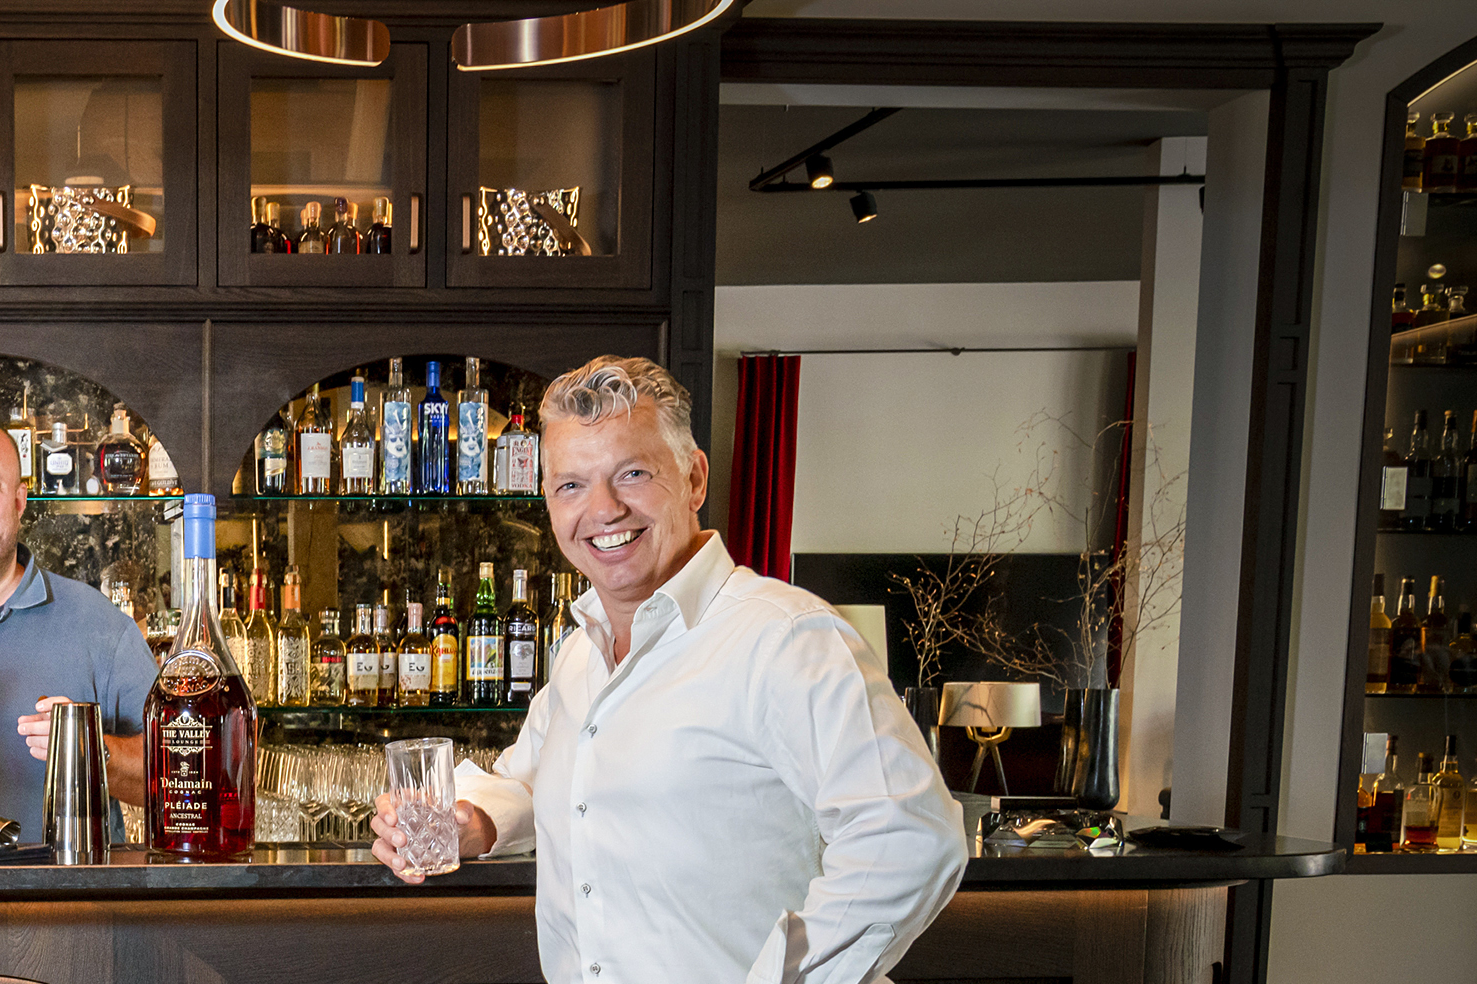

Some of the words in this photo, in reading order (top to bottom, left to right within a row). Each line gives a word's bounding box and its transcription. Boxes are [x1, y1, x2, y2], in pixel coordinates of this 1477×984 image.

[424, 402, 449, 415] SKYY
[162, 730, 177, 738] THE
[178, 730, 211, 738] VALLEY
[160, 777, 213, 790] Delamain
[164, 801, 208, 810] PLÉIADE
